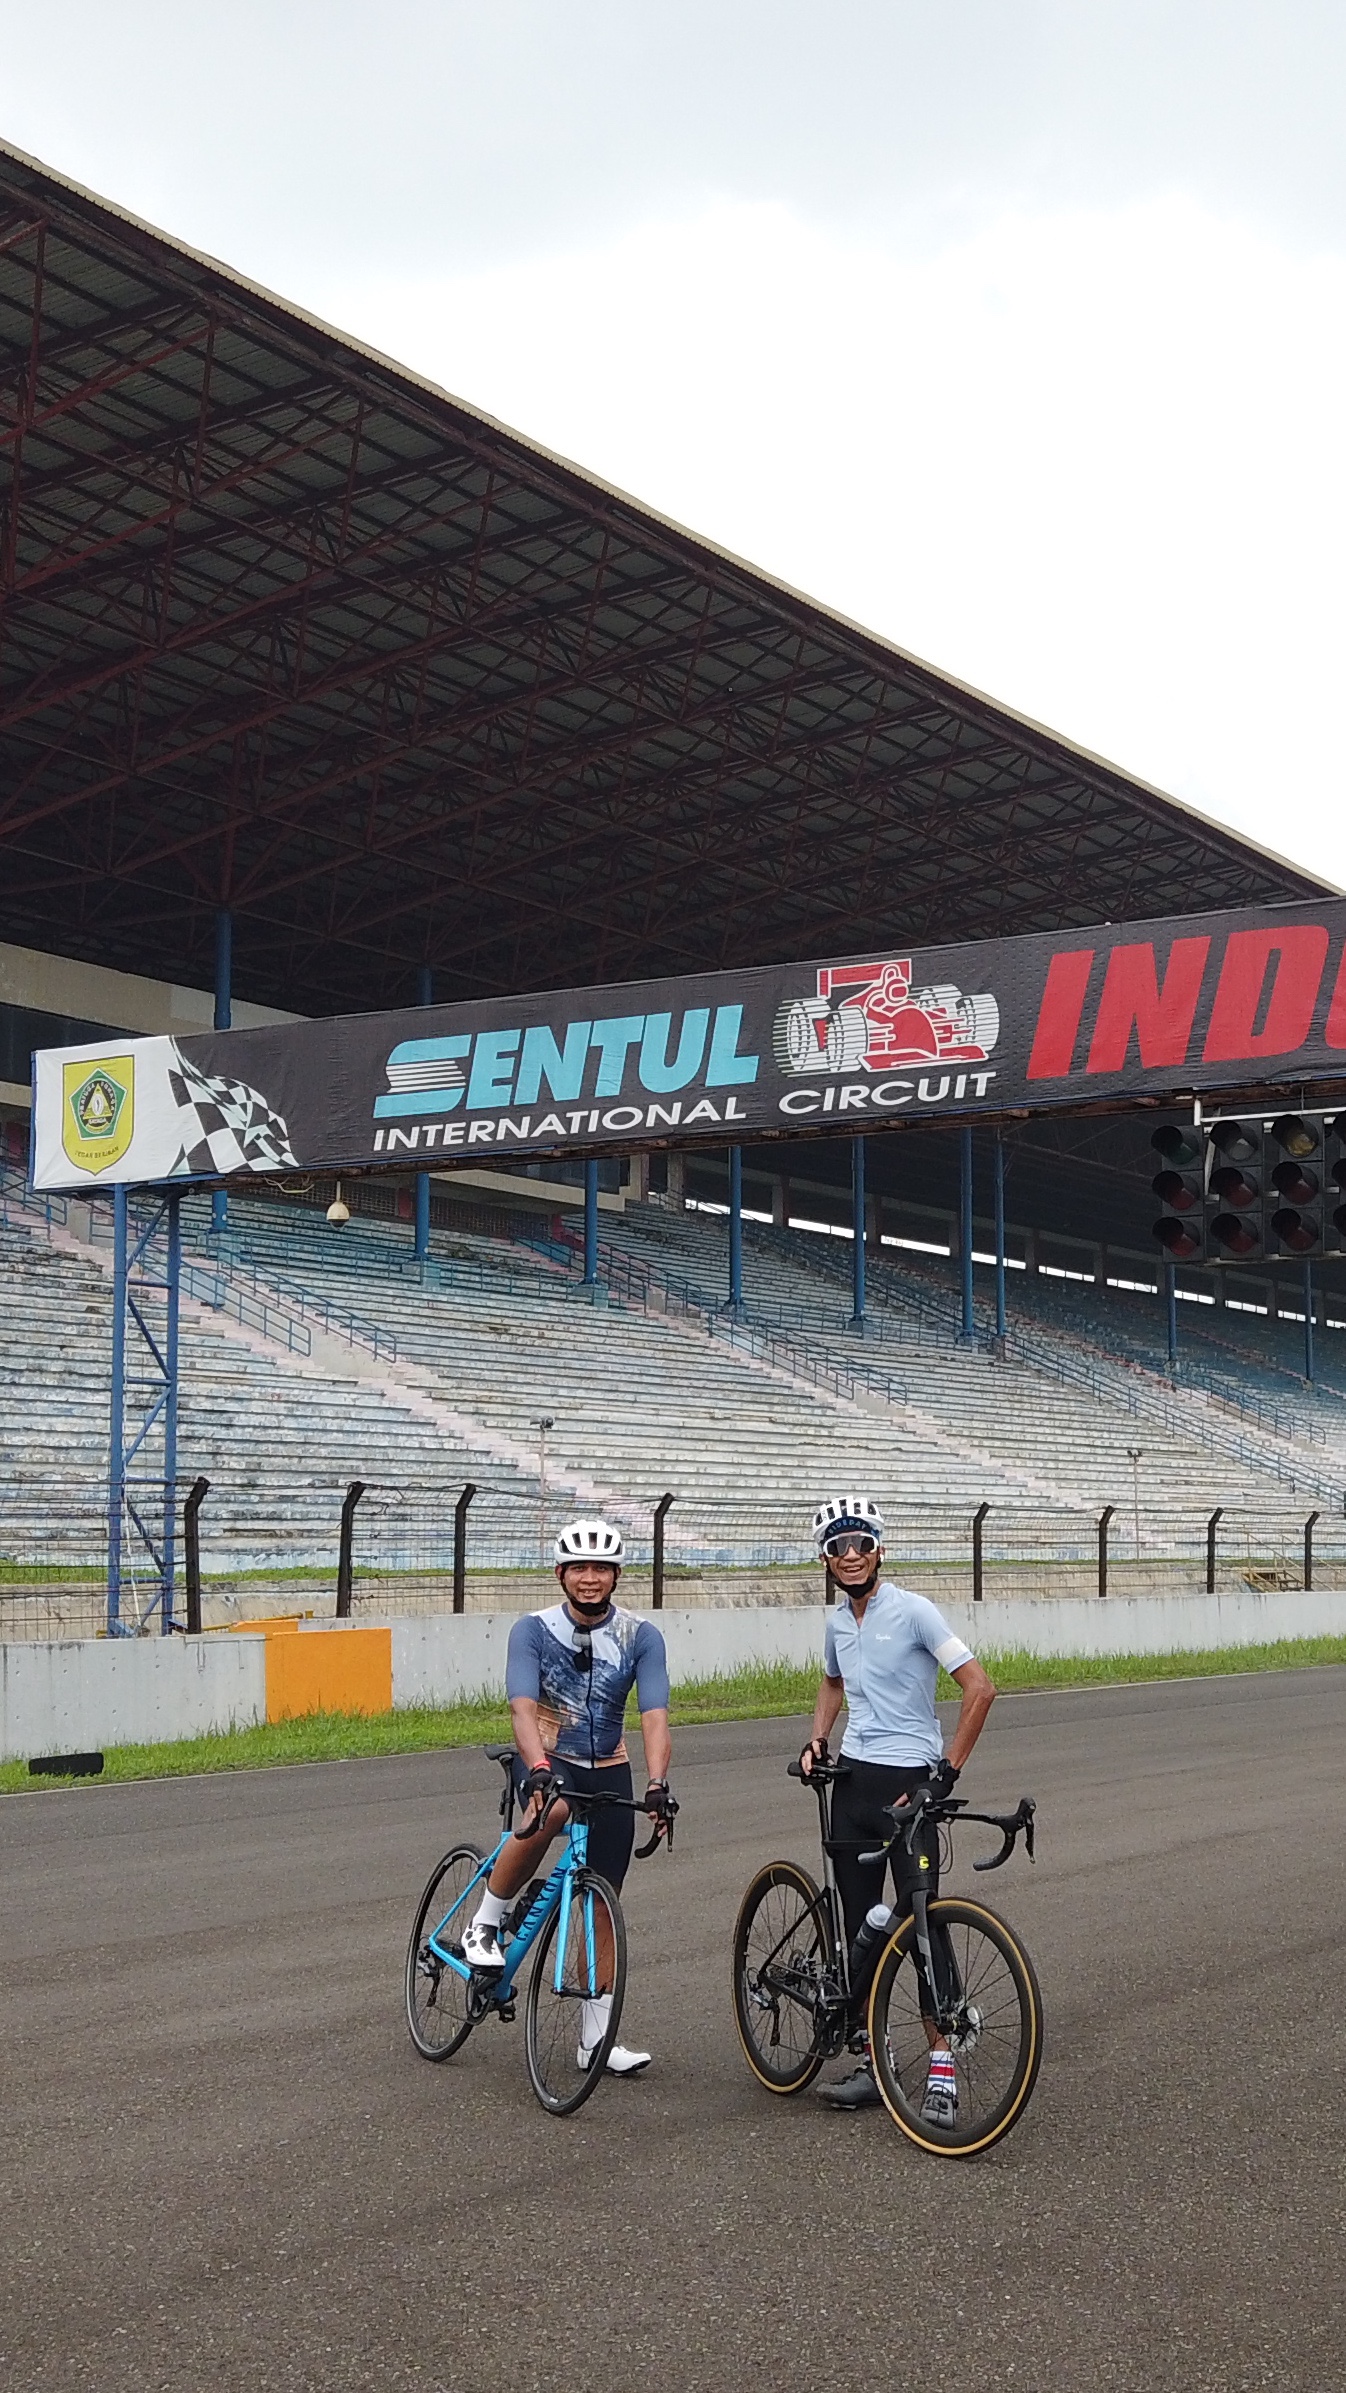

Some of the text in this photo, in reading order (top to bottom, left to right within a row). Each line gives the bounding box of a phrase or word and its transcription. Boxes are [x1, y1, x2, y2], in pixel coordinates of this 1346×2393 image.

[1027, 925, 1346, 1080] IND
[373, 1004, 759, 1118] SENTUL
[373, 1071, 997, 1151] INTERNATIONAL CIRCUIT
[515, 1866, 568, 1942] CANYON
